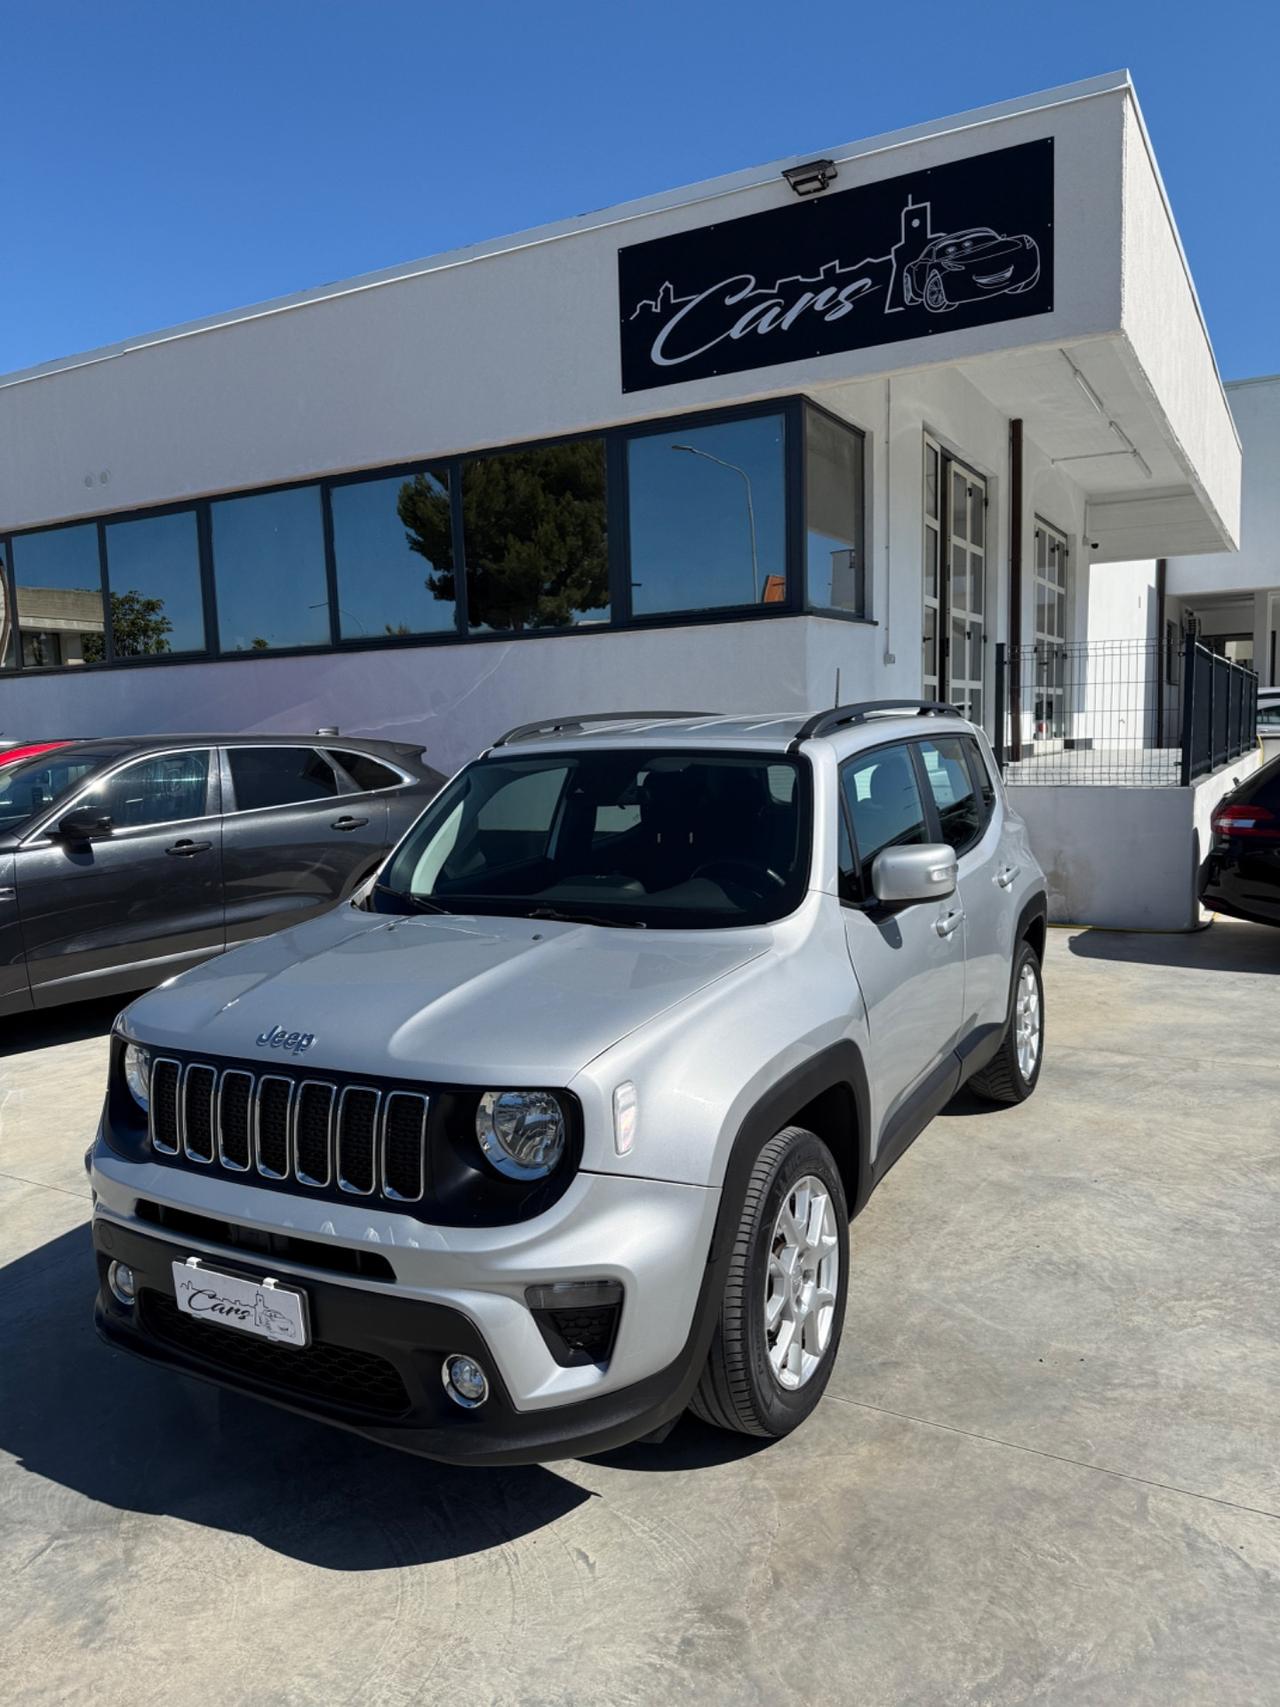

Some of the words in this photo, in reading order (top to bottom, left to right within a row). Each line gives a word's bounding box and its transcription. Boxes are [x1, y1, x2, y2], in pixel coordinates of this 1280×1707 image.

[650, 274, 881, 366] Cars
[256, 1025, 316, 1055] Jeep
[188, 1289, 252, 1320] Cars
